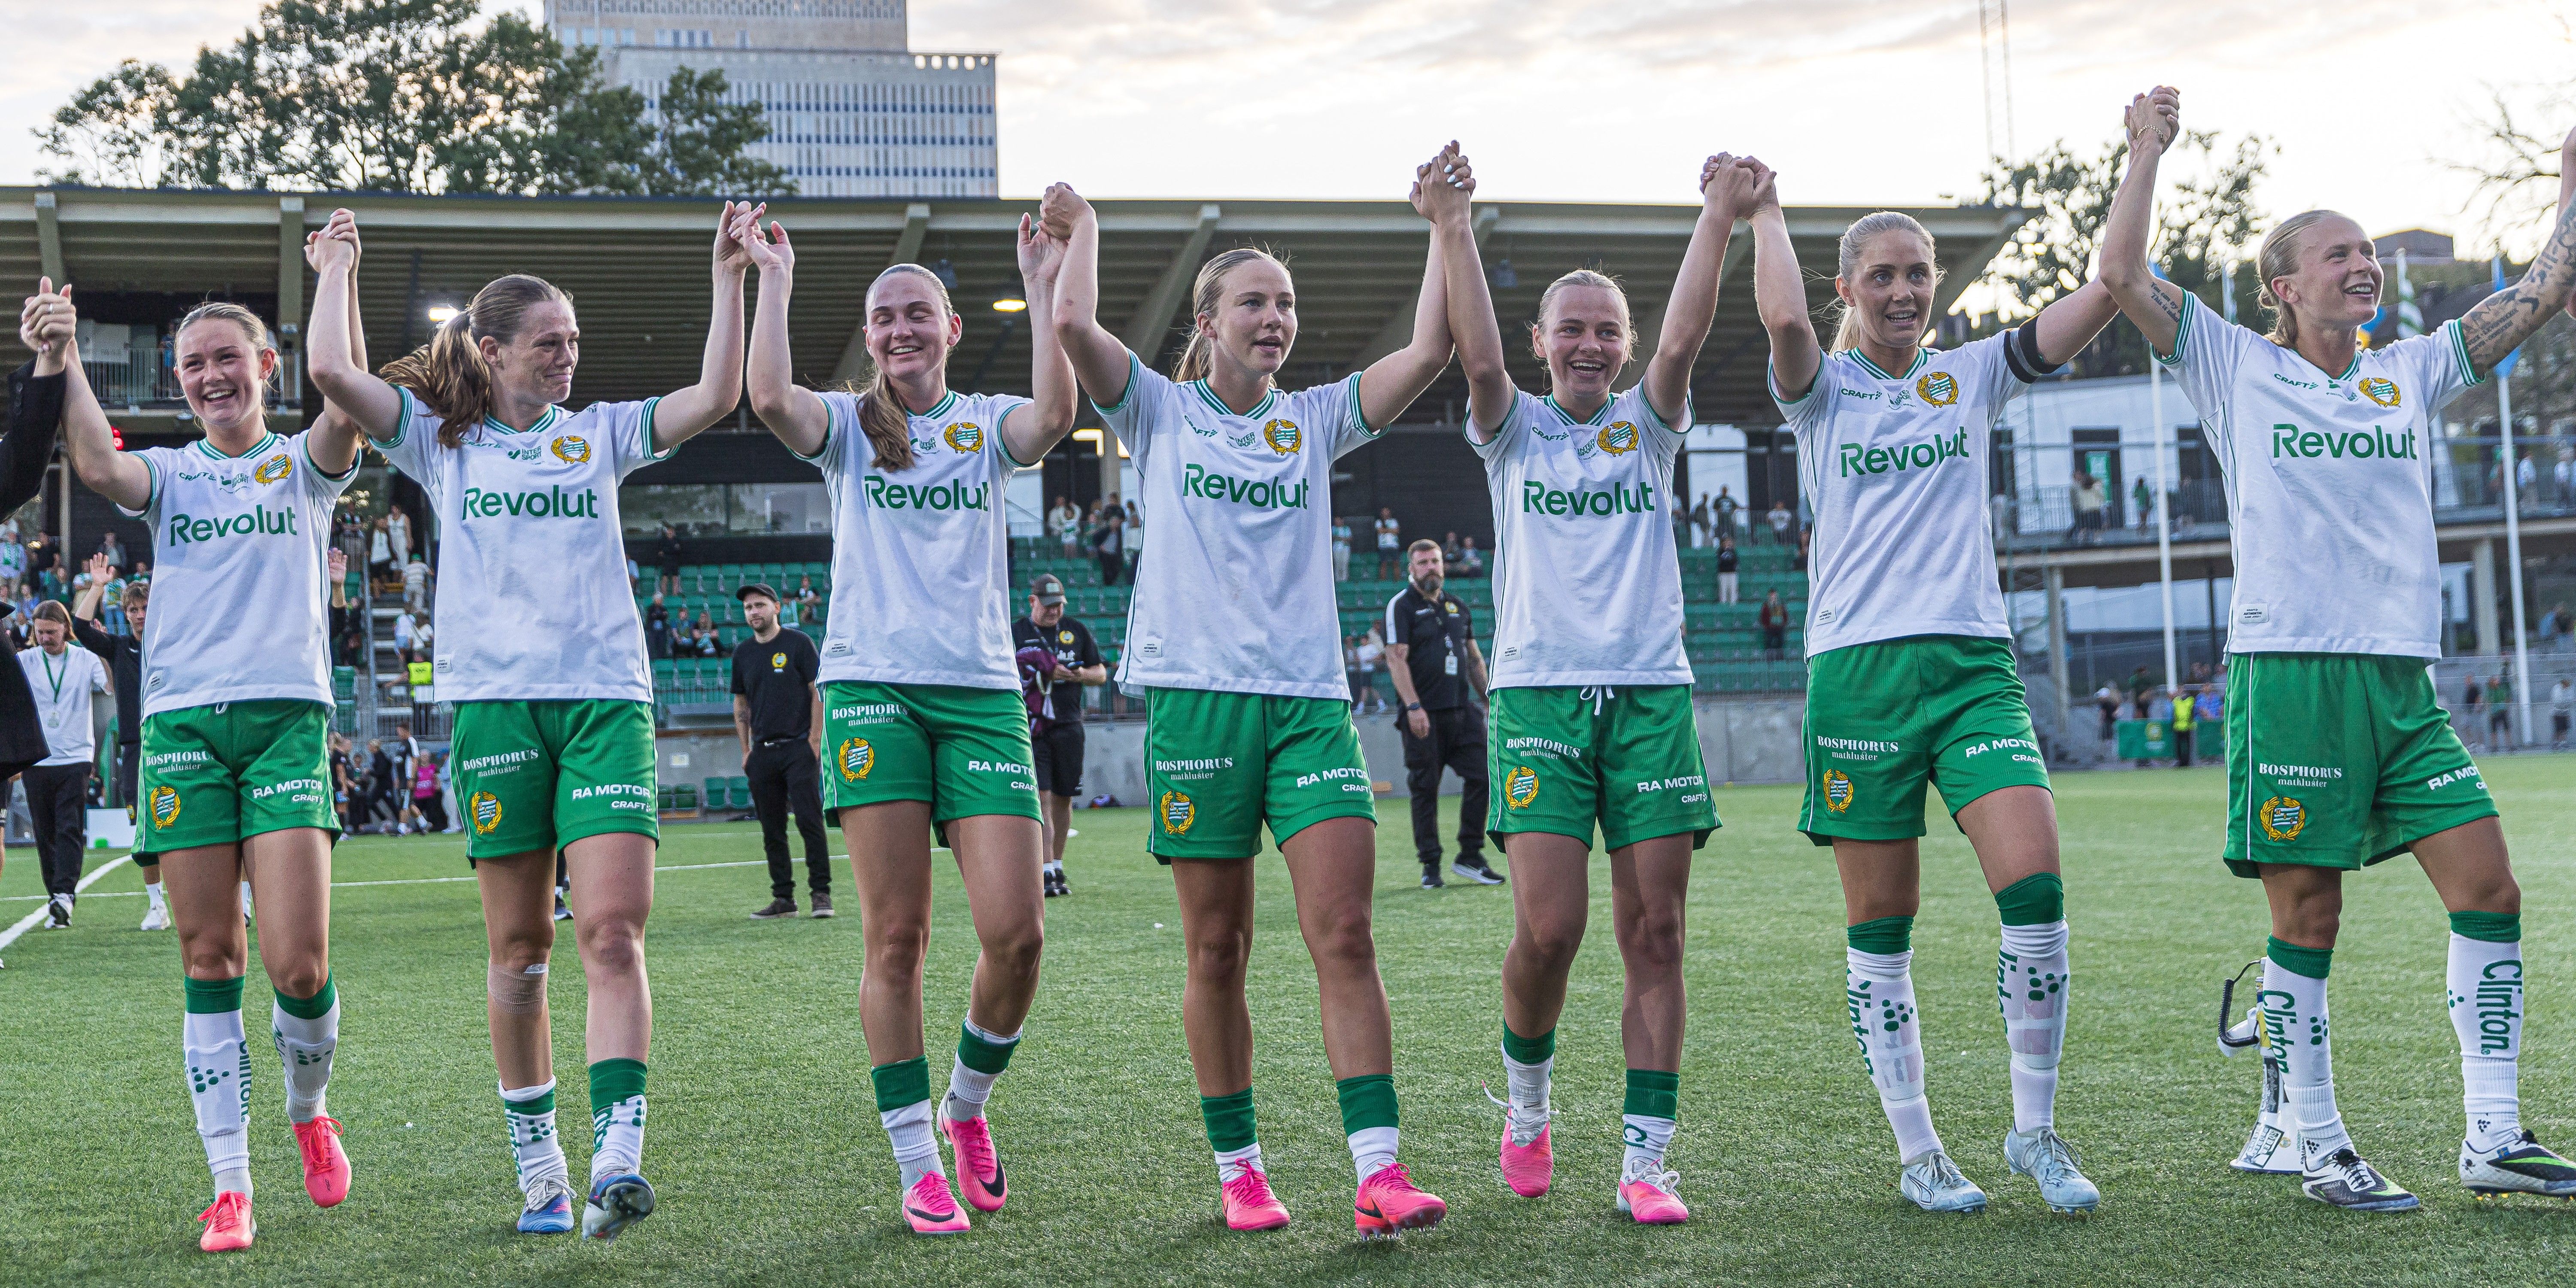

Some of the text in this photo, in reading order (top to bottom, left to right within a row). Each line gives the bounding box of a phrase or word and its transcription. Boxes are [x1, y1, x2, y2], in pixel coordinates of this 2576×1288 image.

[2274, 373, 2310, 389] CRAFT
[1841, 388, 1875, 400] CRAFT
[1184, 415, 1210, 437] CRAFT
[1531, 426, 1562, 441] CRAFT
[460, 437, 492, 448] CRAFT
[1235, 431, 1255, 443] INTER
[2273, 423, 2417, 460] Revolut
[522, 446, 541, 455] INTER
[1577, 438, 1595, 452] INTER
[1577, 443, 1596, 456] SPORT
[1840, 426, 1969, 477] Revolut
[522, 452, 542, 460] SPORT
[179, 472, 209, 481] CRAFT
[1182, 463, 1309, 510] Revolut
[462, 484, 598, 520] Revolut
[1524, 480, 1655, 516] Revolut
[170, 504, 297, 547] Revolut
[832, 704, 909, 720] BOSPHORUS
[1506, 736, 1581, 758] BOSPHORUS
[1817, 735, 1899, 753] BOSPHORUS
[1965, 738, 2039, 758] RA MOTO
[146, 751, 215, 767] BOSPHORU
[463, 748, 539, 772] BOSPHORUS
[1832, 750, 1878, 761] matkluster
[968, 760, 992, 772] RA
[1155, 757, 1233, 772] BOSPHORUS
[2259, 763, 2342, 778] BOSPHORUS
[1170, 770, 1214, 781] matkluster
[1297, 775, 1320, 788] RA
[2278, 778, 2327, 788] matkluster
[2427, 774, 2455, 791] RA
[252, 779, 323, 799] RA MOTOR
[1342, 784, 1369, 793] CRAFT
[1637, 775, 1704, 793] RA MOTOR
[292, 794, 319, 803] CRAFT
[572, 784, 651, 800] RA MOTOR
[1681, 793, 1703, 803] CRAFT
[611, 800, 646, 811] CRAFT
[2263, 990, 2297, 1074] Clinton
